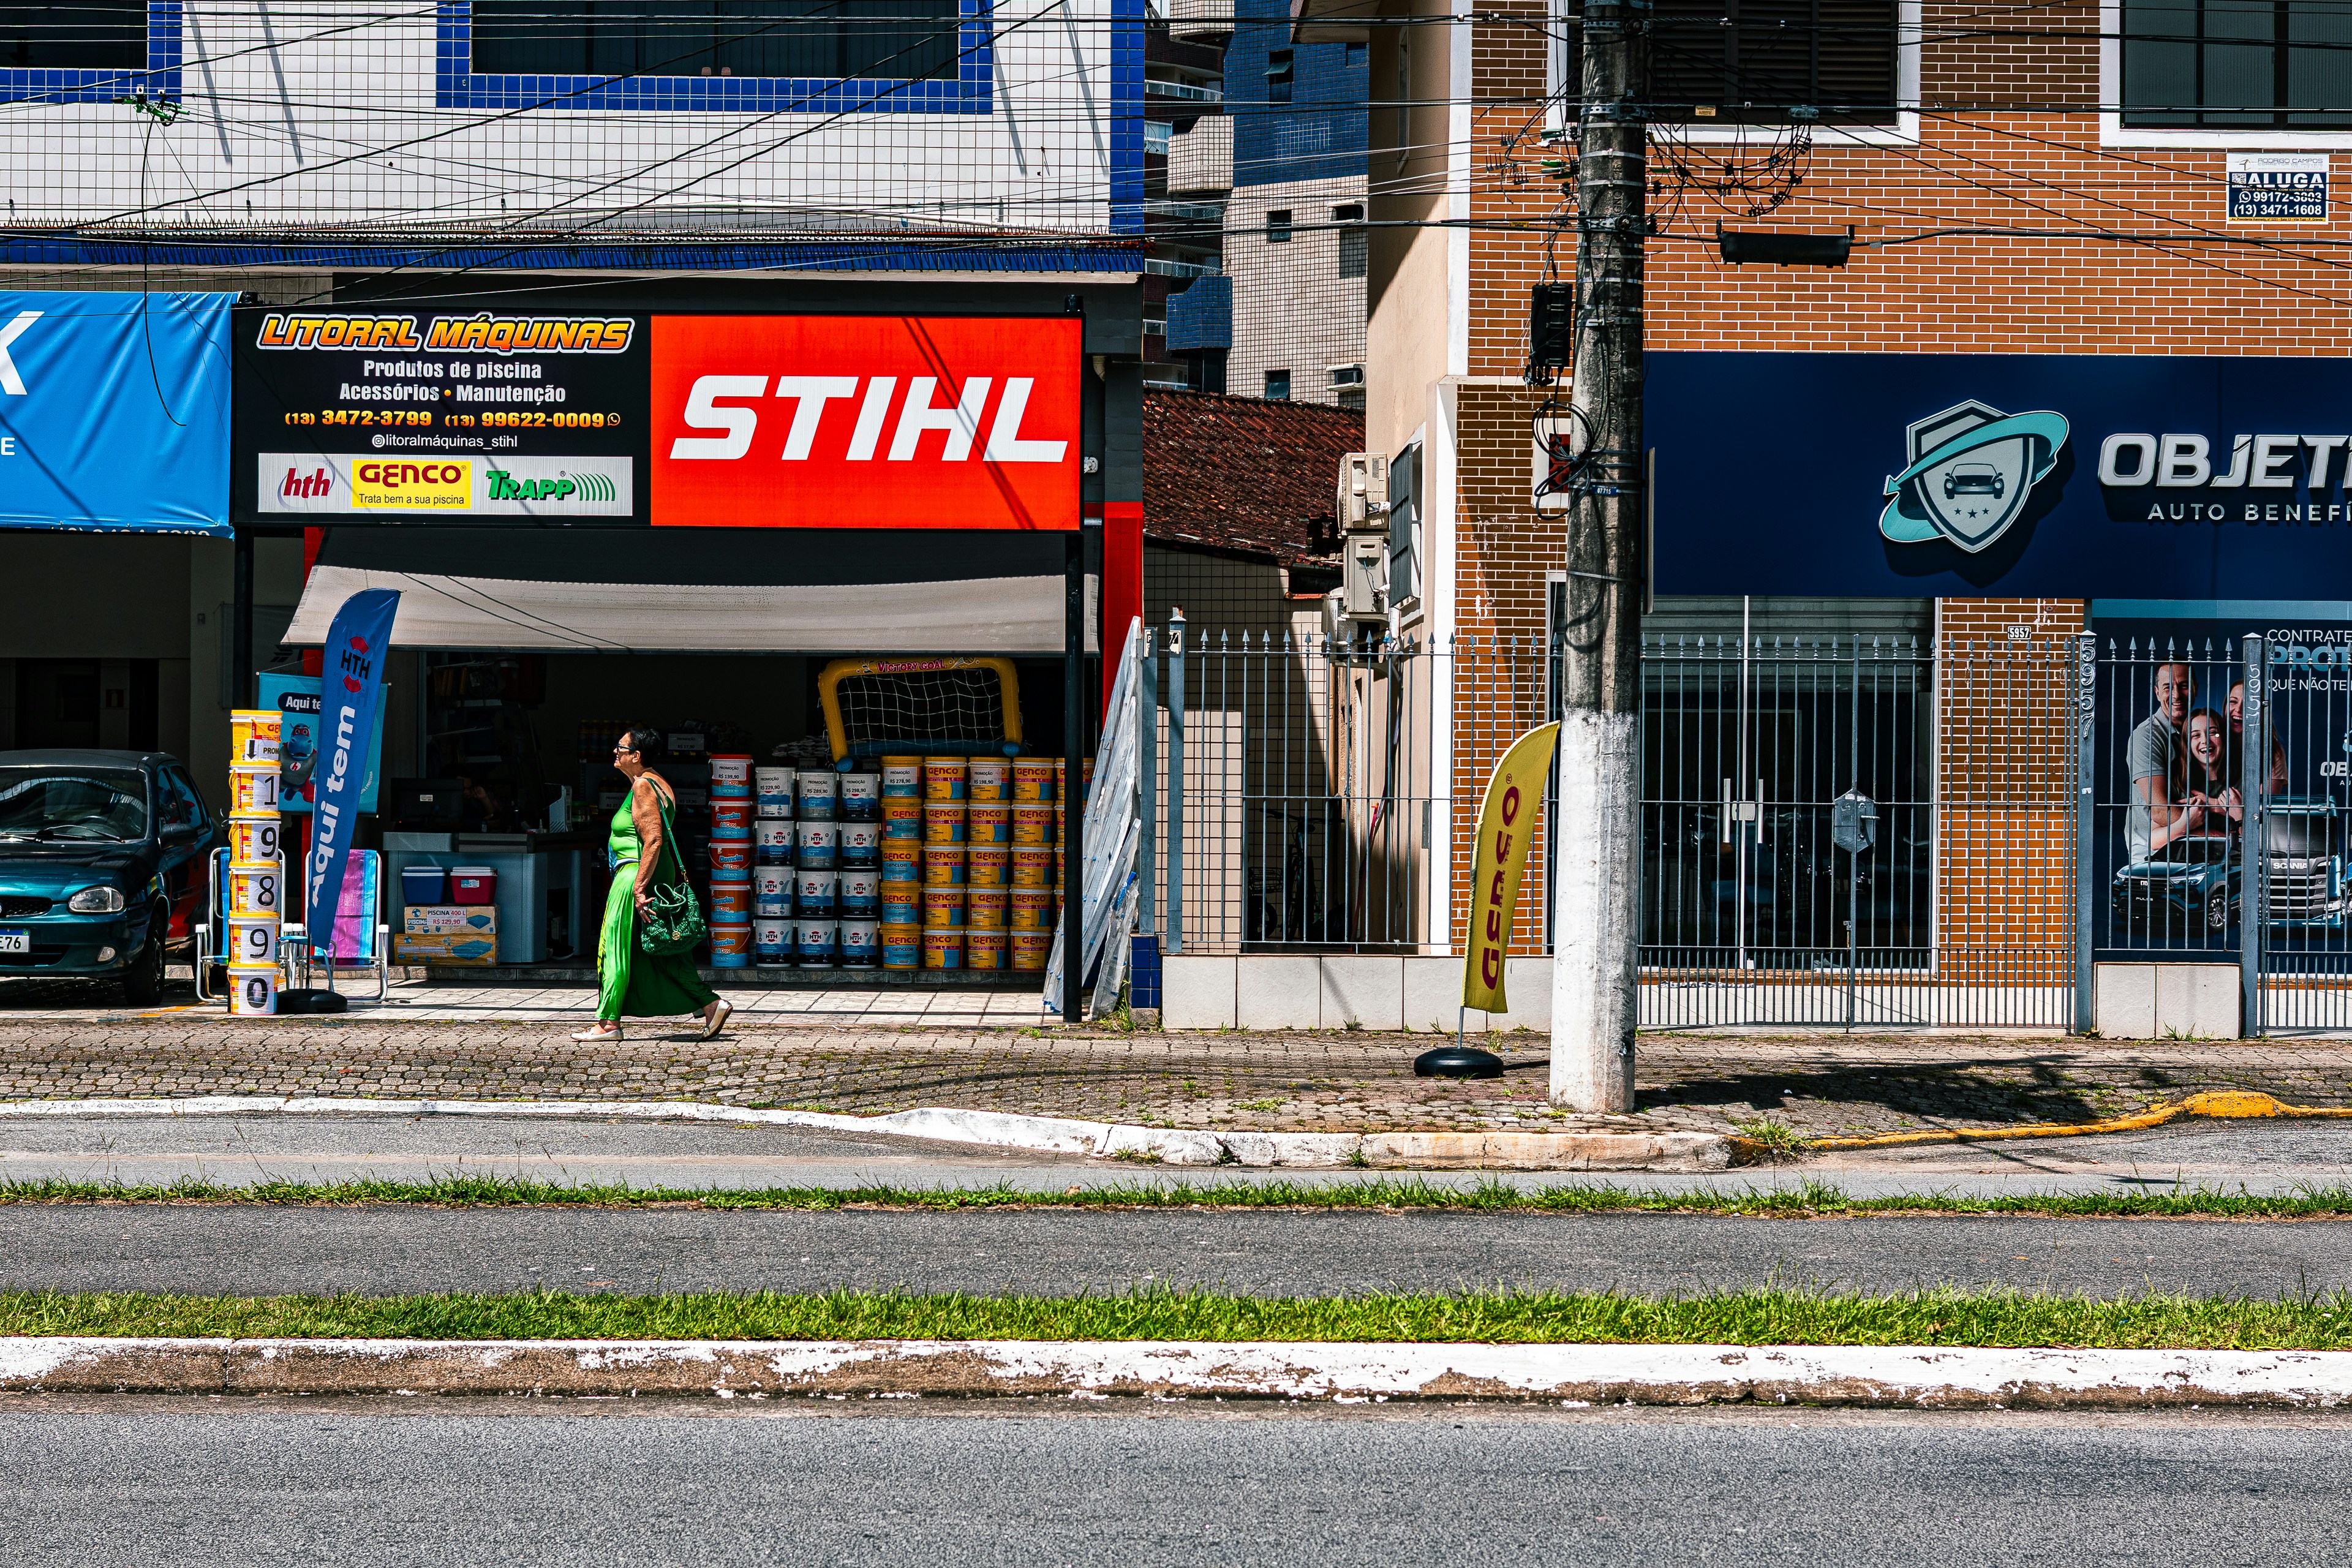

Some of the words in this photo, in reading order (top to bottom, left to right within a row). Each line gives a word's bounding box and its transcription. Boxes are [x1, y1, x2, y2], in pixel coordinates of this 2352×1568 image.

[2247, 173, 2324, 189] ALUGA
[2234, 204, 2257, 217] (13)
[2260, 204, 2322, 215] 3471-1608
[260, 317, 420, 349] LITORAL
[427, 314, 631, 353] MÁQUINAS
[363, 360, 444, 378] Produtos
[449, 361, 471, 378] de
[477, 361, 541, 380] piscina
[339, 383, 440, 401] Acessórios
[456, 385, 566, 405] Manutenção
[284, 412, 315, 425] (13)
[322, 410, 432, 426] 3472-3799
[445, 415, 475, 427] (13)
[481, 412, 605, 427] 99622-0009
[669, 374, 1069, 462] STIHL
[283, 467, 331, 499] hth
[359, 464, 462, 488] GENCO
[485, 470, 576, 501] TRAPP
[358, 493, 382, 503] Trata
[384, 494, 404, 504] bem
[433, 495, 464, 506] piscina
[2147, 503, 2225, 521] AUTO
[2009, 627, 2030, 638] 5957
[340, 649, 371, 680] HTH
[876, 660, 919, 673] VICTORY
[919, 658, 947, 670] GOAL
[2081, 638, 2095, 738] 5957
[2267, 679, 2296, 692] QUE
[2299, 677, 2329, 691] NÃO
[286, 696, 310, 711] Aqui
[312, 699, 321, 709] te
[928, 767, 959, 776] GENCO
[264, 775, 277, 805] 1
[312, 801, 339, 909] Aqui
[326, 706, 356, 793] tem
[929, 810, 959, 818] GENCO
[260, 826, 277, 858] 9
[257, 875, 275, 907] 8
[1481, 785, 1522, 991] GENCO
[249, 928, 268, 959] 9
[246, 977, 268, 1008] 0
